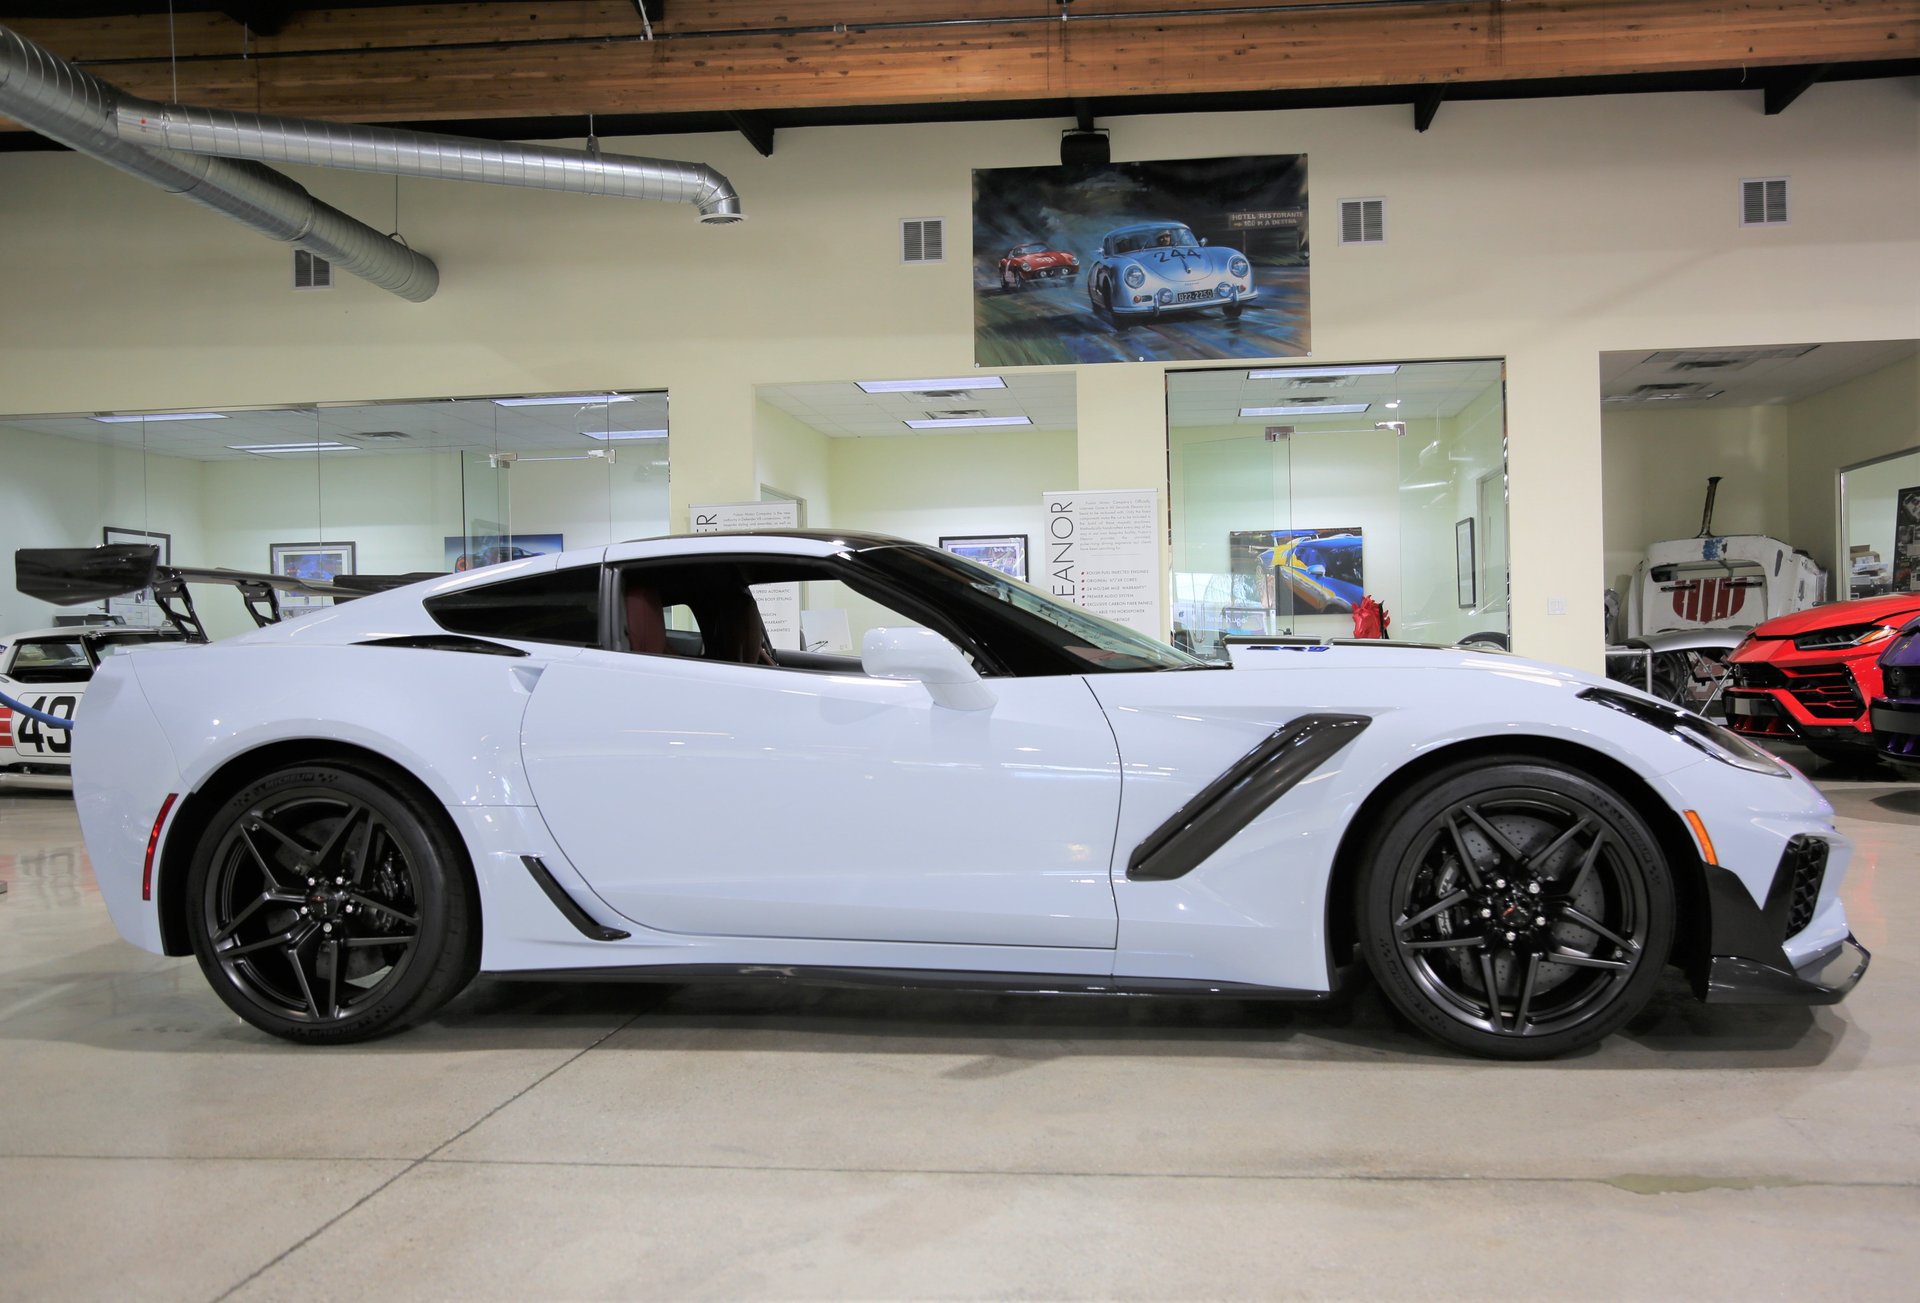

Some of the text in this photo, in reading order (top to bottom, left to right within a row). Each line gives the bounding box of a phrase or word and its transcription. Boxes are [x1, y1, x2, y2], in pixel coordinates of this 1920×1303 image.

[1154, 248, 1201, 262] 244
[1051, 502, 1075, 604] EANOR
[18, 696, 76, 753] 49
